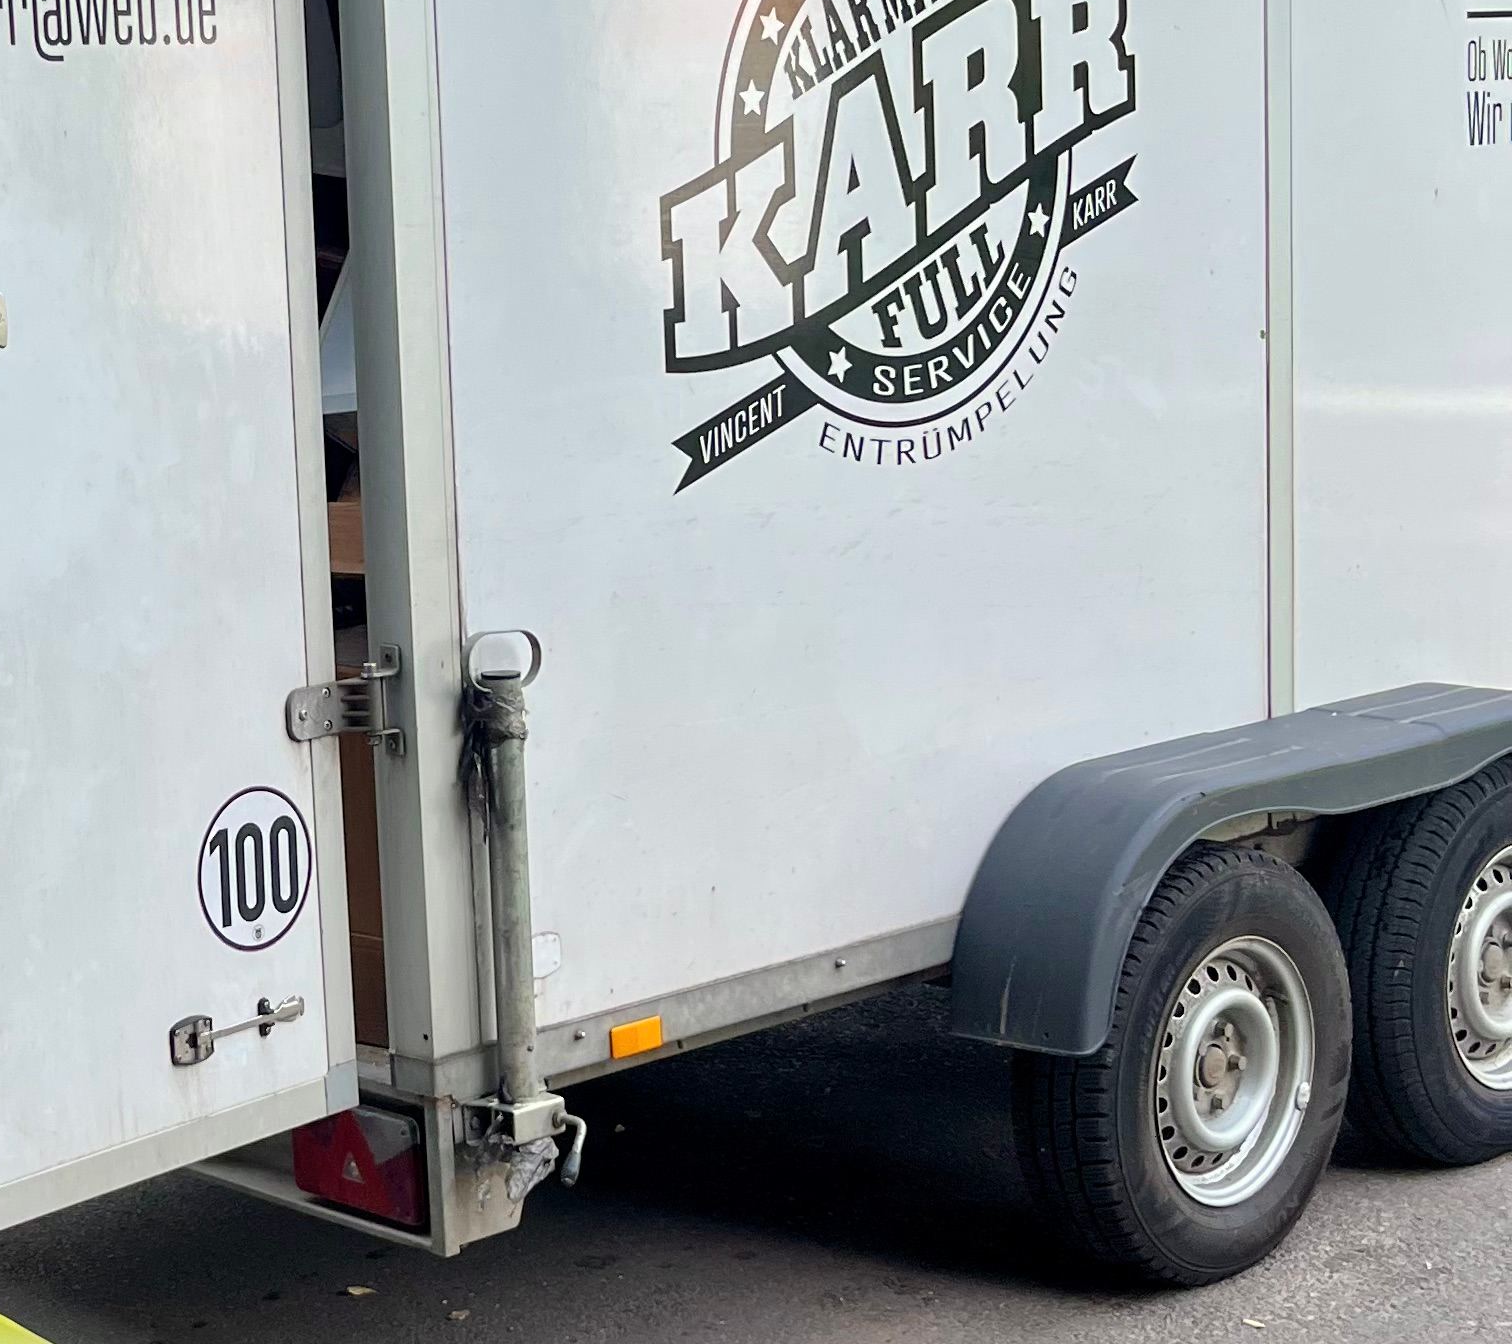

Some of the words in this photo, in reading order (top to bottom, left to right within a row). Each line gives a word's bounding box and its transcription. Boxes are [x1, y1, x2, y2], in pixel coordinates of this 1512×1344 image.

[1468, 36, 1487, 82] Ob
[1467, 90, 1503, 146] Wir
[1073, 179, 1118, 231] KARR
[872, 223, 1005, 348] FULL
[872, 262, 1032, 396] SERVICE
[819, 266, 1078, 466] ENTRÜMPELUNG
[700, 384, 786, 464] VINCENT
[209, 815, 300, 929] 100
